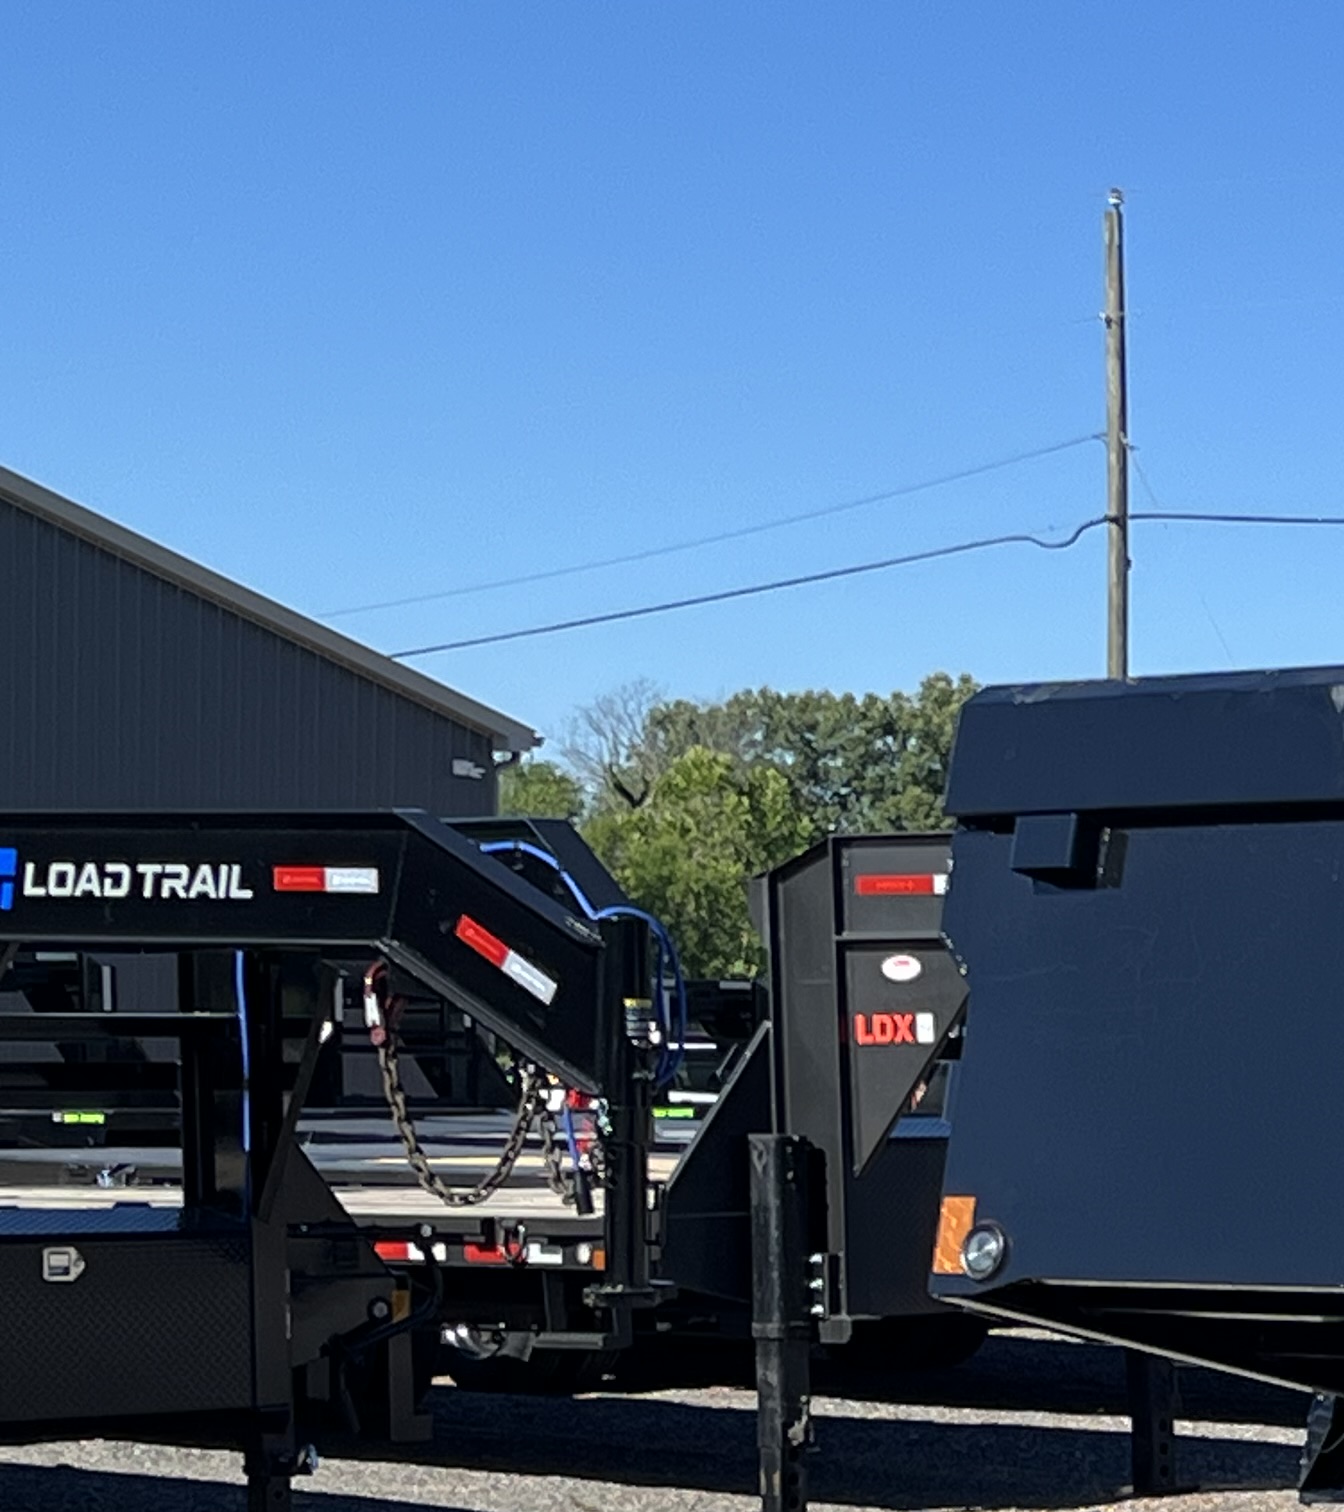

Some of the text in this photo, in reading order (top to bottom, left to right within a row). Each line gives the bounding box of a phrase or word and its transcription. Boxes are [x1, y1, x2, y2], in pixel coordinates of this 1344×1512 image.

[23, 862, 253, 899] LOAD TRAIL
[855, 1012, 915, 1046] LDX
